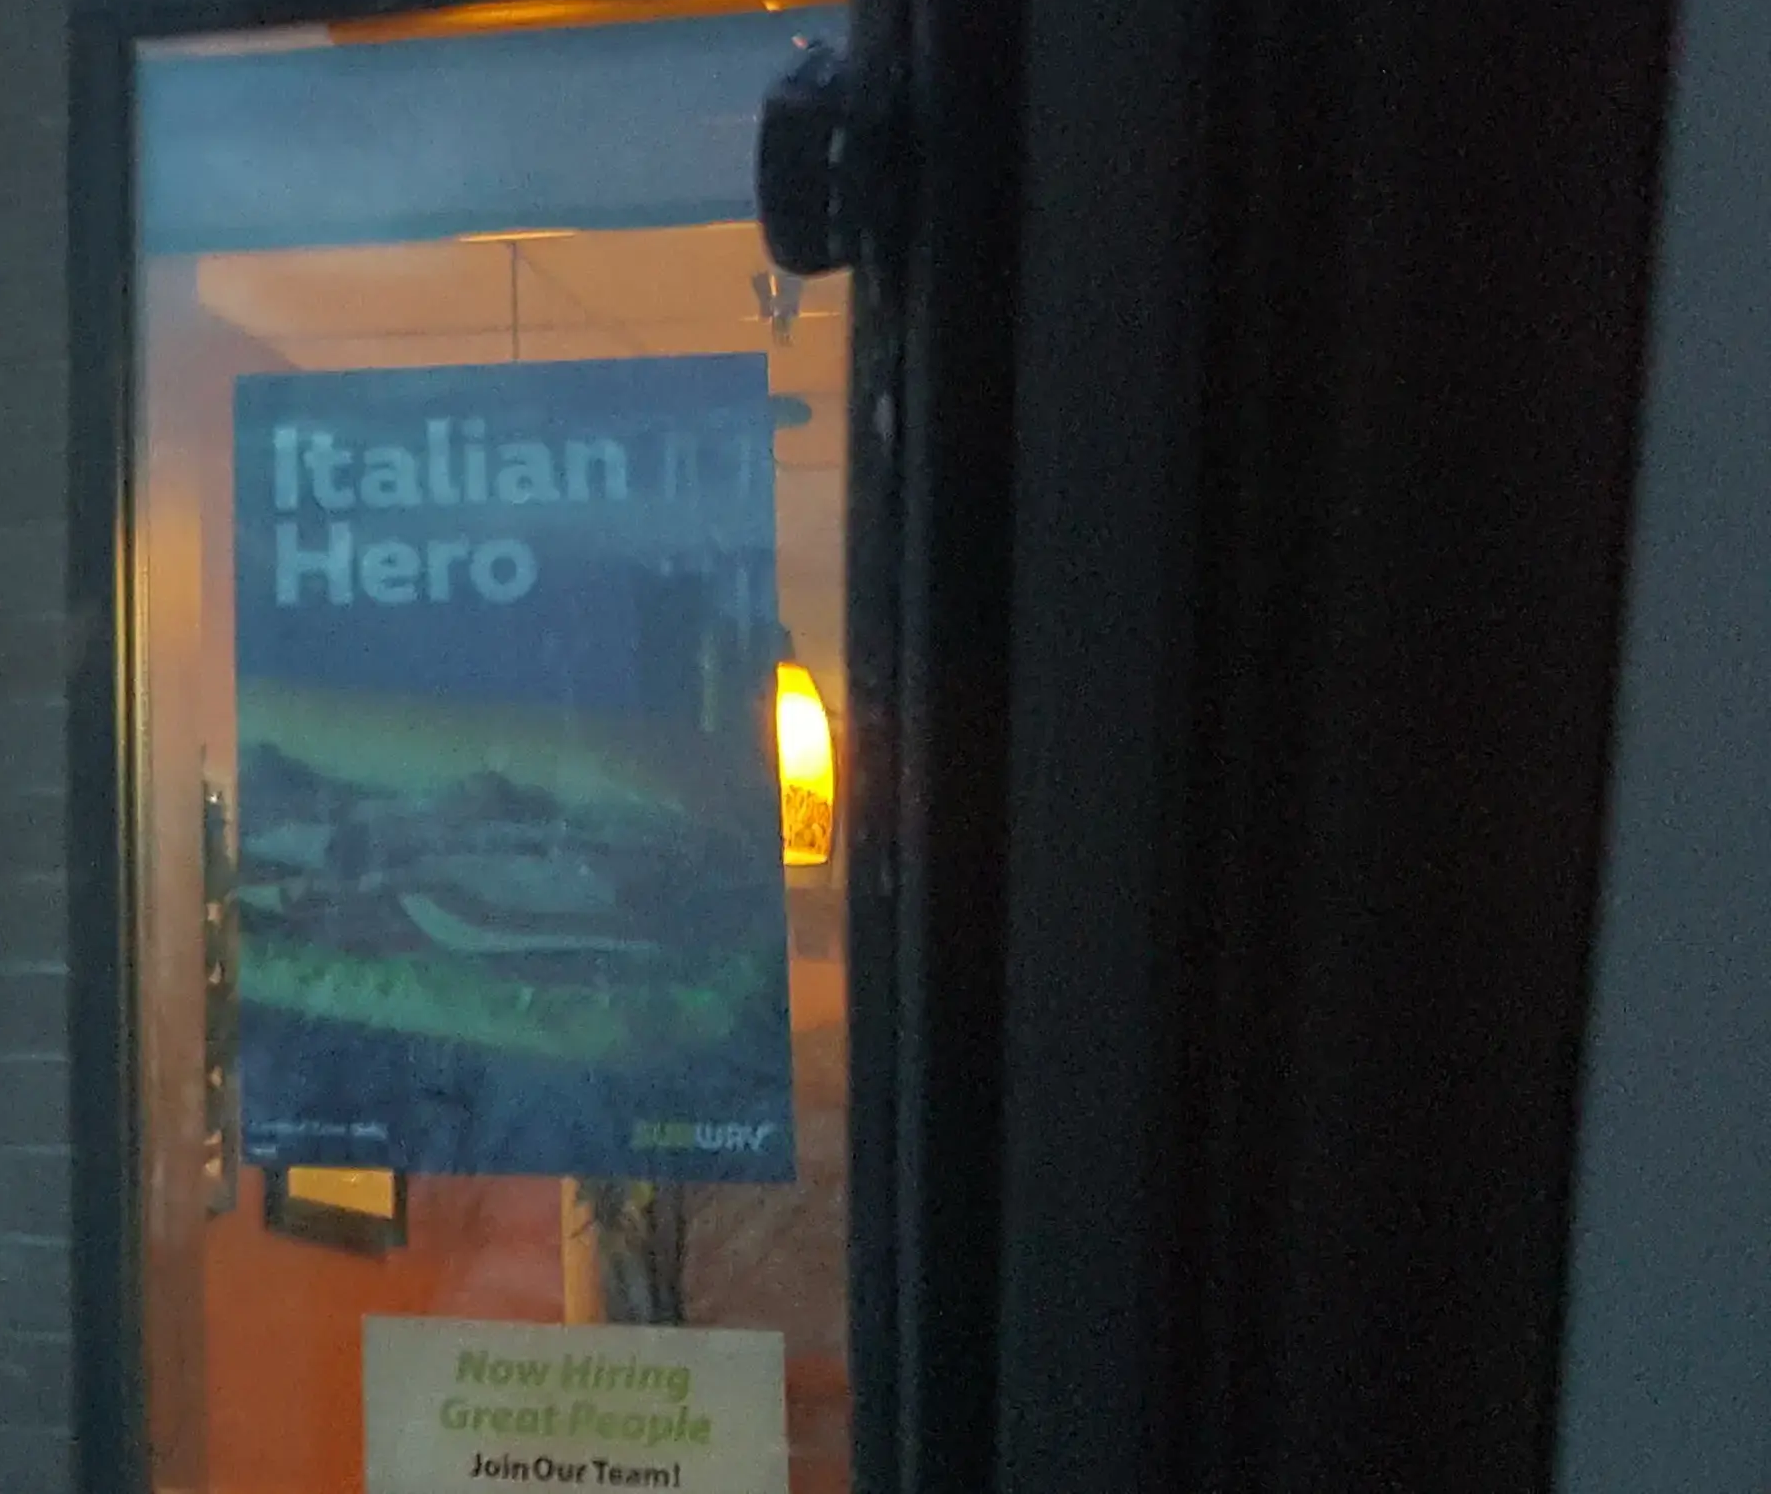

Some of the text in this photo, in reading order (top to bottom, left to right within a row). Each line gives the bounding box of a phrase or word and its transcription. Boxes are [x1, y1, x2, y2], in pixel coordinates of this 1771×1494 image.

[273, 416, 629, 510] Italian
[273, 518, 538, 606] Hero
[631, 1118, 775, 1152] UWAY
[456, 1350, 691, 1402] Now Hiring
[440, 1396, 712, 1447] Great People
[470, 1453, 681, 1489] Join Our Team!
